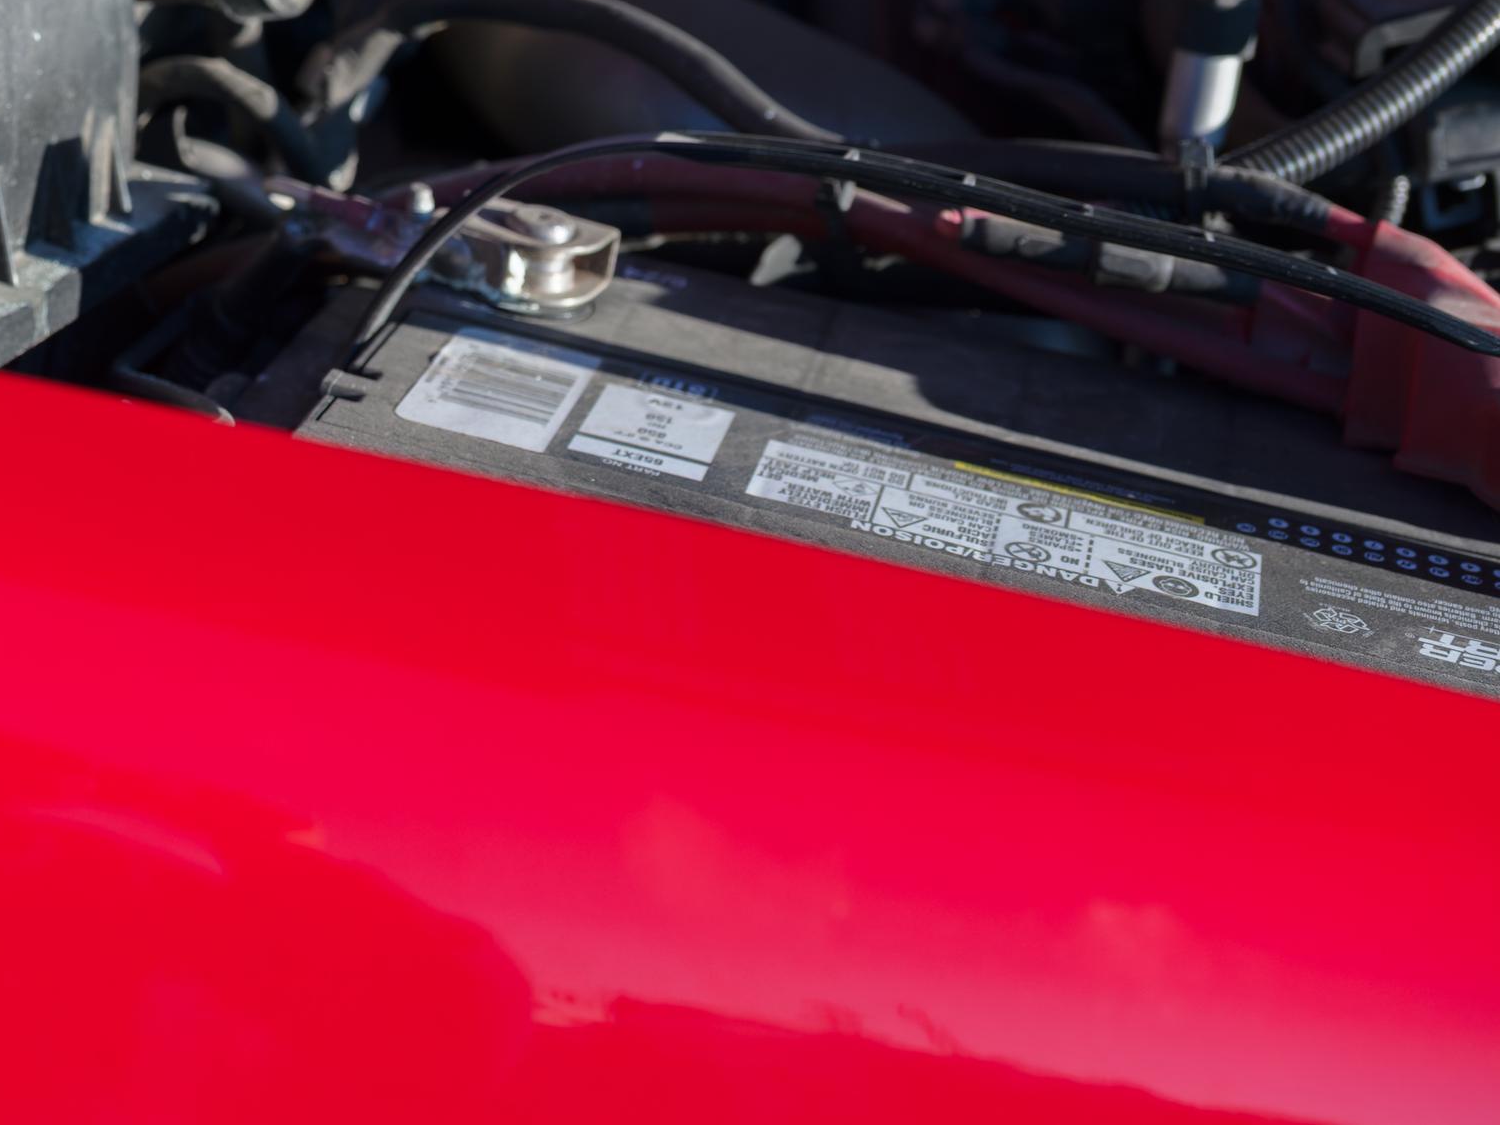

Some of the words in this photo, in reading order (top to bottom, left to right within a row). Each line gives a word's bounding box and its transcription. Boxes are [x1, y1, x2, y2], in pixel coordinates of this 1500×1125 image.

[612, 448, 664, 467] 65EXT
[625, 463, 661, 477] PART
[758, 470, 784, 482] GET
[762, 465, 820, 484] MEDICAL
[783, 481, 834, 499] WATER.
[778, 487, 870, 515] IMMEDIATELY
[787, 496, 822, 510] EYES
[837, 495, 872, 508] WITH
[909, 501, 926, 509] OR
[954, 493, 973, 503] ALL
[825, 505, 868, 521] FLUSH
[927, 512, 965, 526] CAUSE
[929, 505, 994, 527] BLINDNESS
[952, 505, 996, 521] SEVERE
[958, 526, 991, 540] ACID
[968, 522, 993, 533] CAN
[1082, 517, 1144, 538] CHILDREN.
[1104, 528, 1125, 539] THE
[922, 524, 990, 548] SULFURIC
[1129, 534, 1144, 544] OF
[1147, 532, 1163, 542] OF
[1149, 539, 1172, 550] OUT
[1168, 537, 1205, 552] REACH
[1175, 545, 1204, 558] KEEP
[850, 520, 1100, 589] DANGER/POISON
[1061, 555, 1081, 567] NO
[1118, 547, 1185, 570] BLINDNESS
[1129, 557, 1174, 575] GASES
[1188, 564, 1227, 580] CAUSE
[1189, 559, 1235, 576] INJURY.
[1178, 569, 1255, 594] EXPLOSIVE
[1231, 575, 1255, 587] CAN
[1239, 571, 1256, 580] OR
[1310, 581, 1352, 596] California
[1314, 577, 1359, 592] chemicals
[1205, 591, 1254, 610] SHIELD
[1214, 585, 1254, 602] EYES.
[1305, 586, 1356, 602] accessories
[1363, 594, 1387, 604] State
[1383, 593, 1416, 605] contain
[1357, 598, 1389, 610] related
[1388, 600, 1403, 608] the
[1390, 606, 1407, 614] and
[1417, 601, 1437, 610] also
[1414, 606, 1443, 617] known
[1437, 605, 1477, 619] Batteries
[1419, 643, 1500, 674] ER
